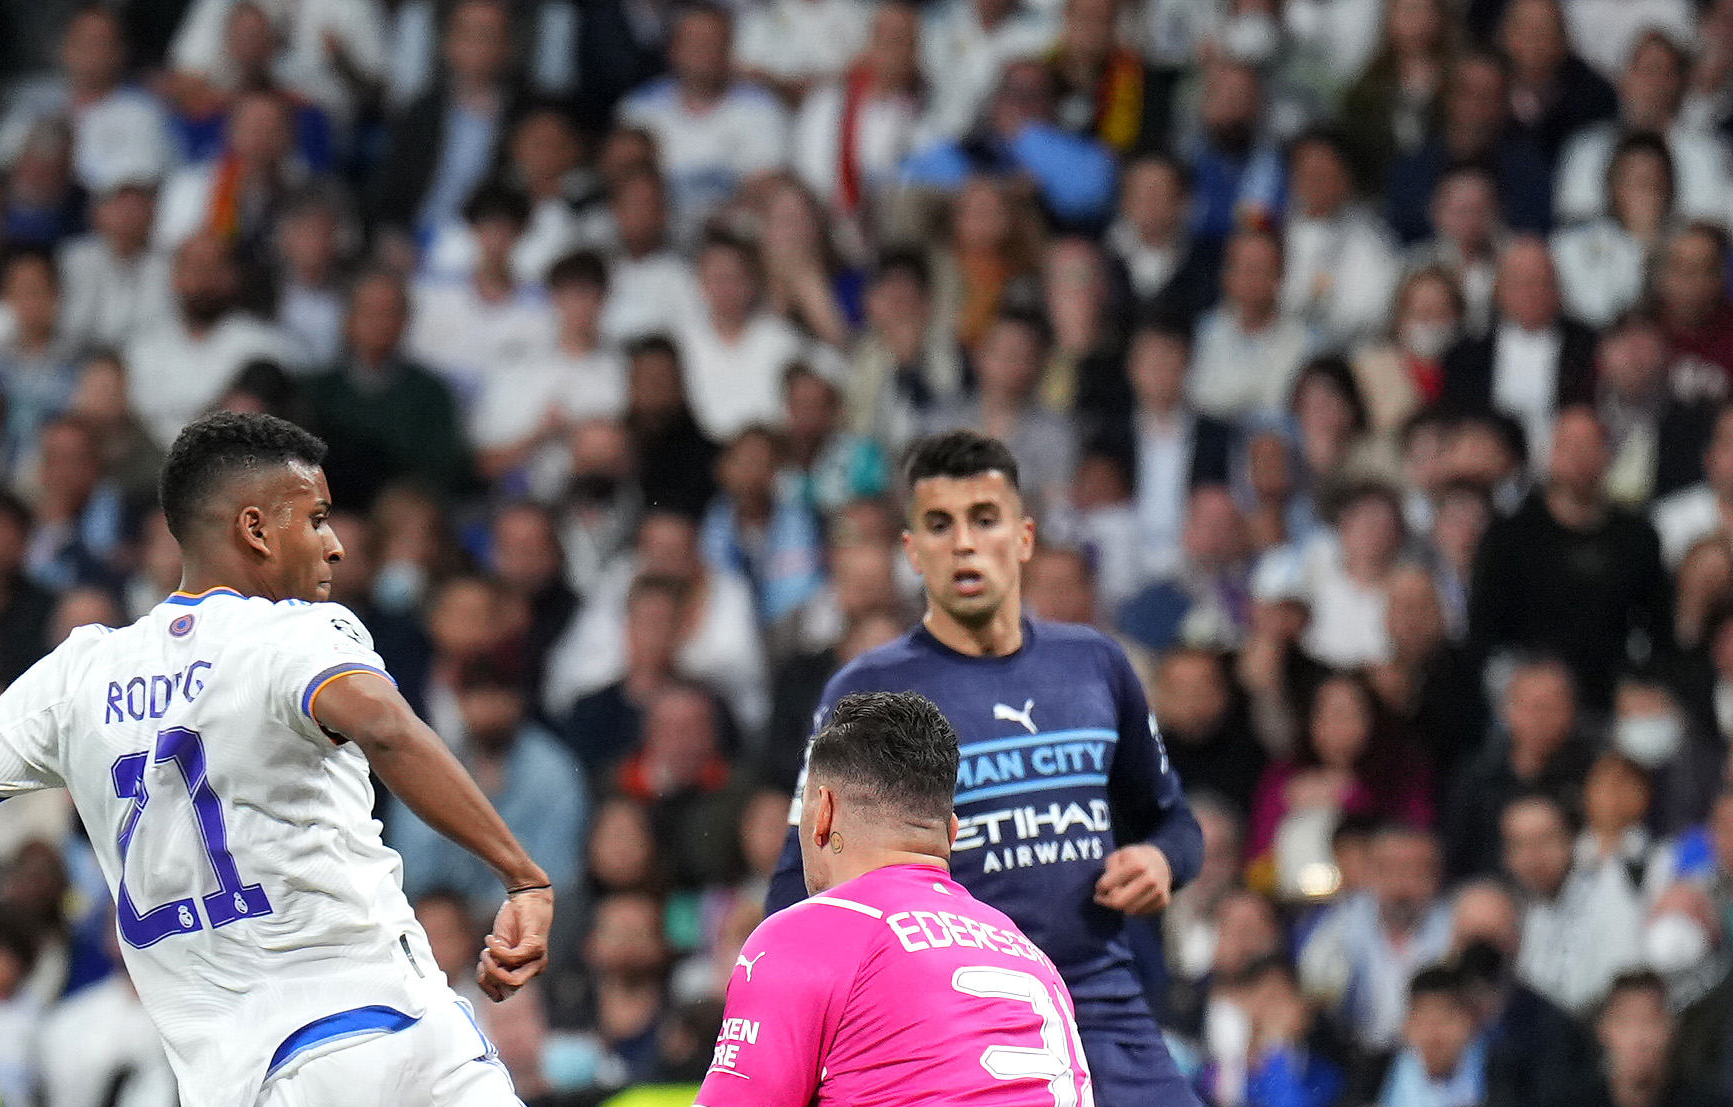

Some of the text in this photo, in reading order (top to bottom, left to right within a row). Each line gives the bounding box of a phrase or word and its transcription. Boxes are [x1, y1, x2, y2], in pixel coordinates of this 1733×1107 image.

[957, 742, 1107, 789] MAN CITY
[111, 726, 273, 949] 21
[951, 799, 1112, 852] ETIHAD
[983, 836, 1104, 875] AIRWAYS
[713, 1044, 741, 1068] RE
